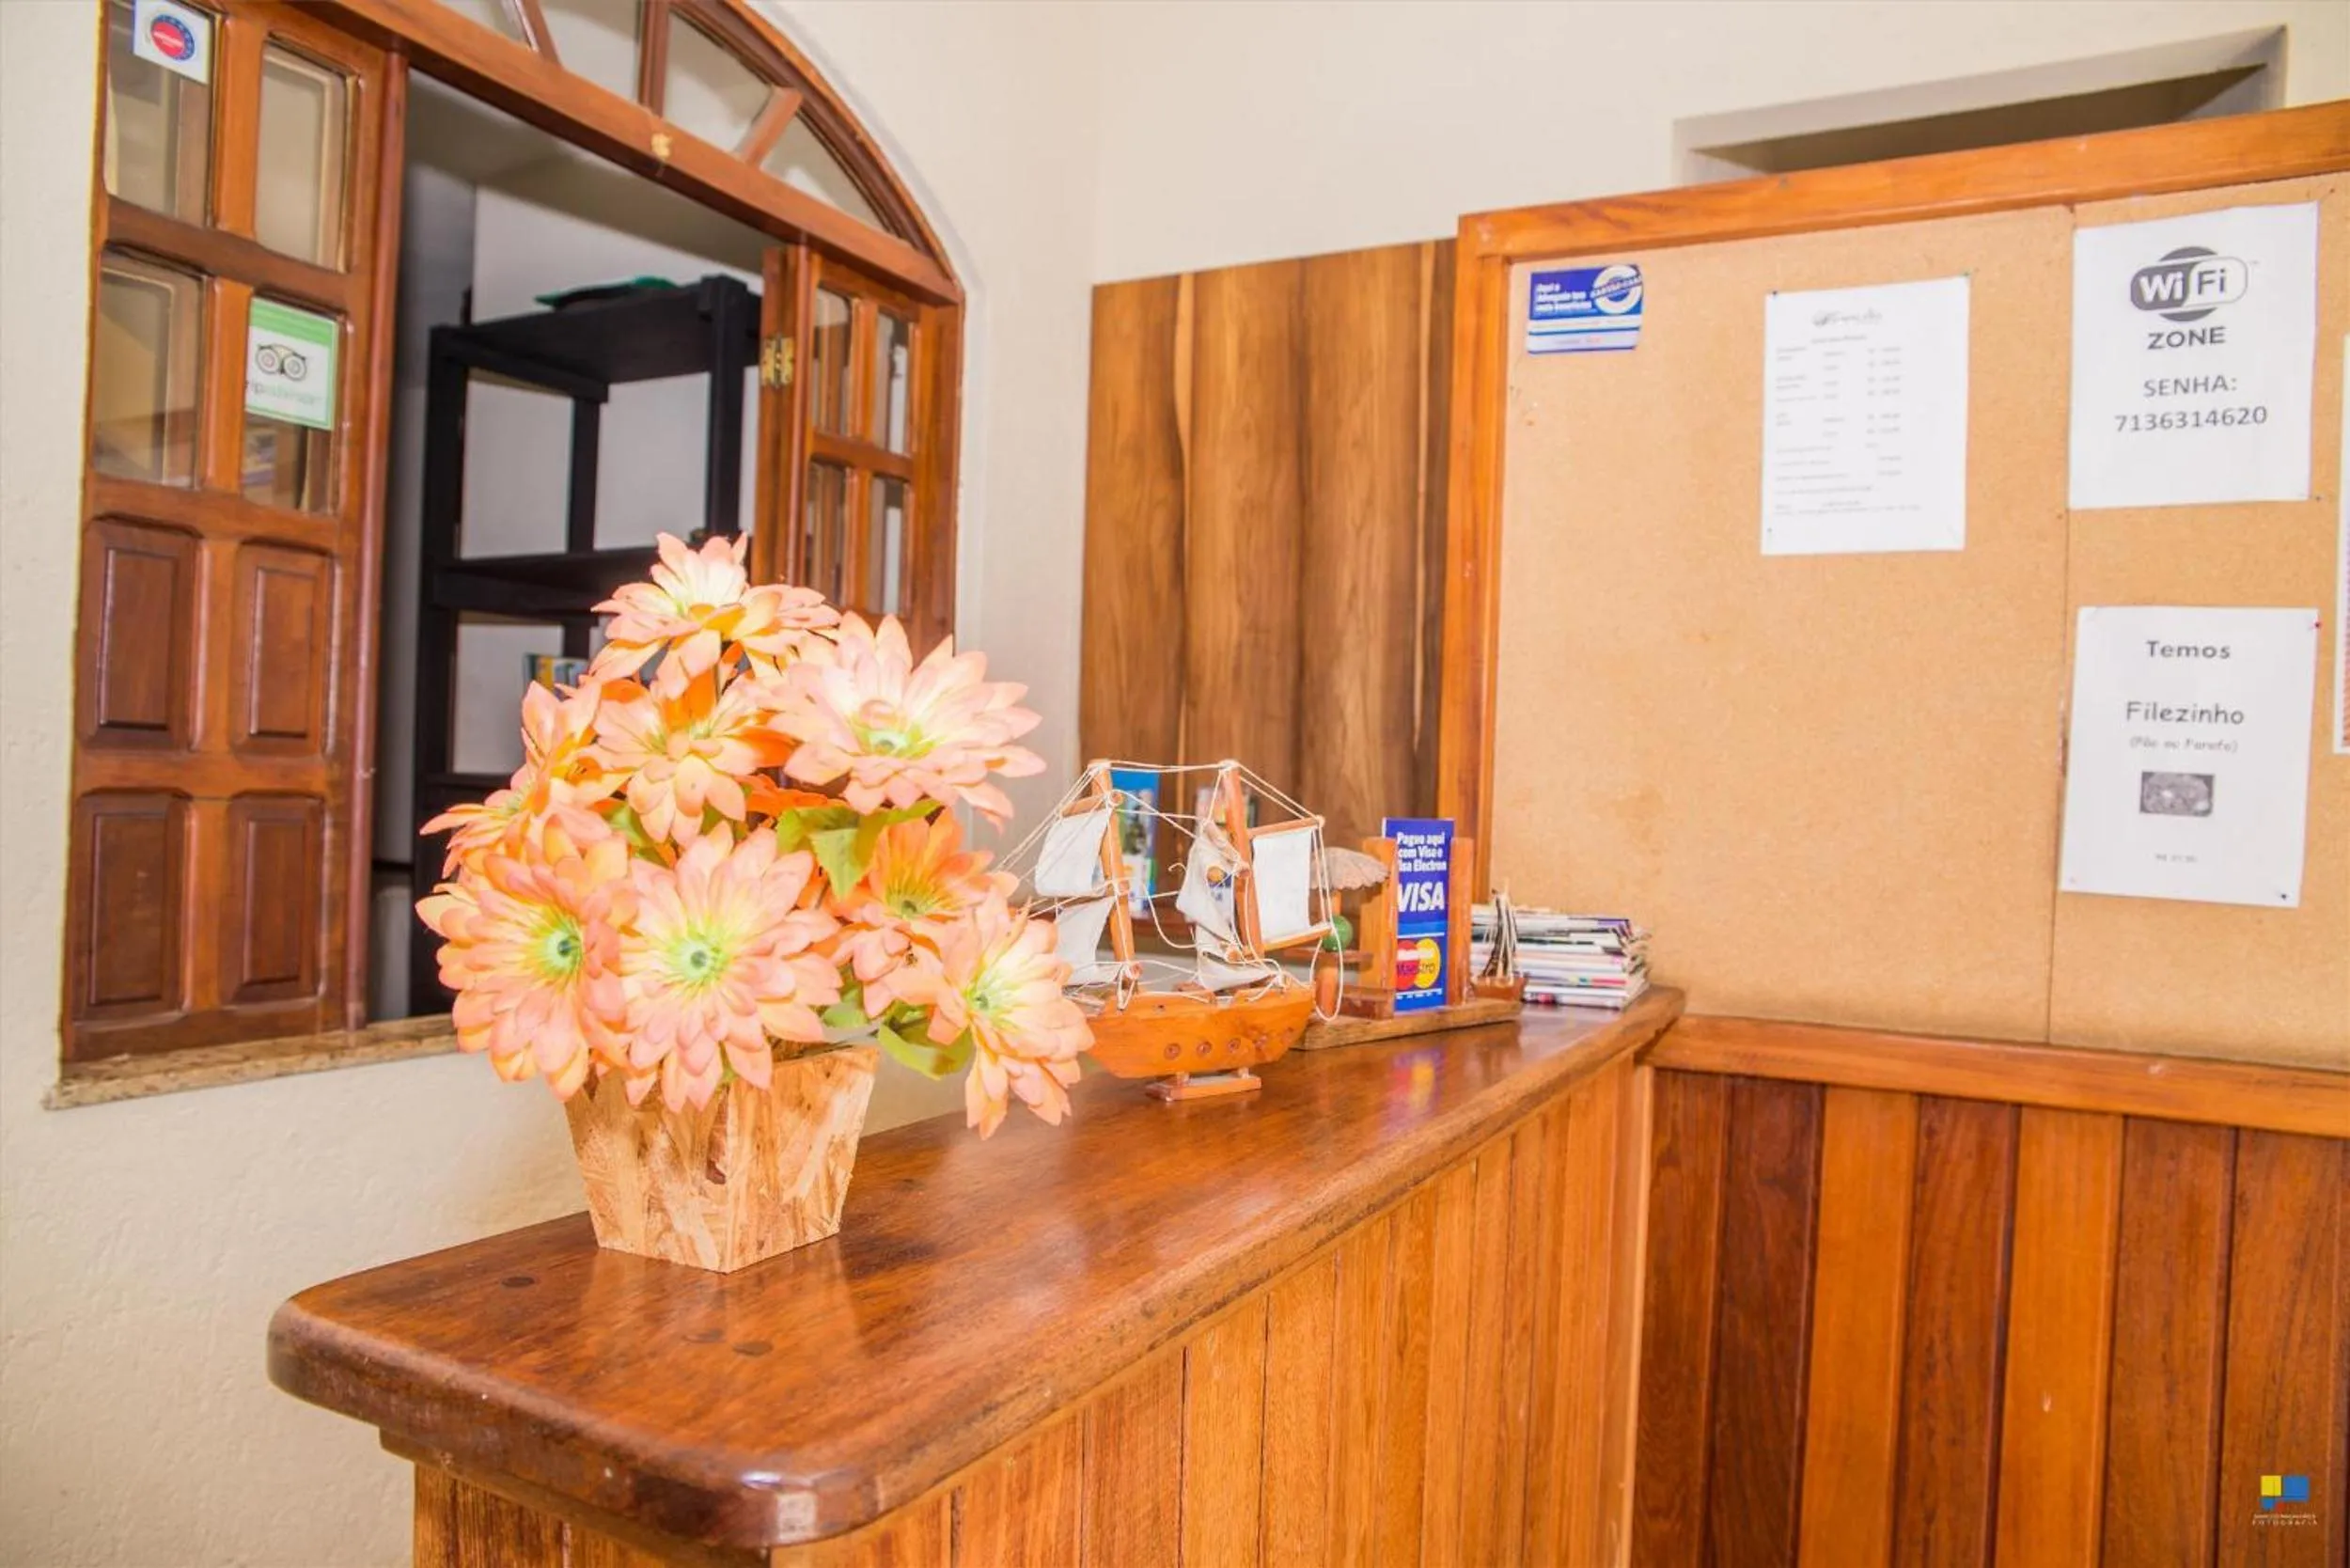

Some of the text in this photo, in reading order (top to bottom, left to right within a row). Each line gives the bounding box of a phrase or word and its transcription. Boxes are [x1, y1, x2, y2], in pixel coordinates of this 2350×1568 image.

[2147, 326, 2226, 350] ZONE
[2143, 374, 2237, 398] SENHA:
[2115, 405, 2268, 432] 7136314620
[2145, 639, 2231, 660] Temos
[2125, 700, 2245, 726] Filezinho
[1397, 832, 1446, 847] Pague aqui
[1398, 847, 1417, 858] com
[1413, 858, 1448, 872] Electron
[1398, 881, 1445, 913] VISA
